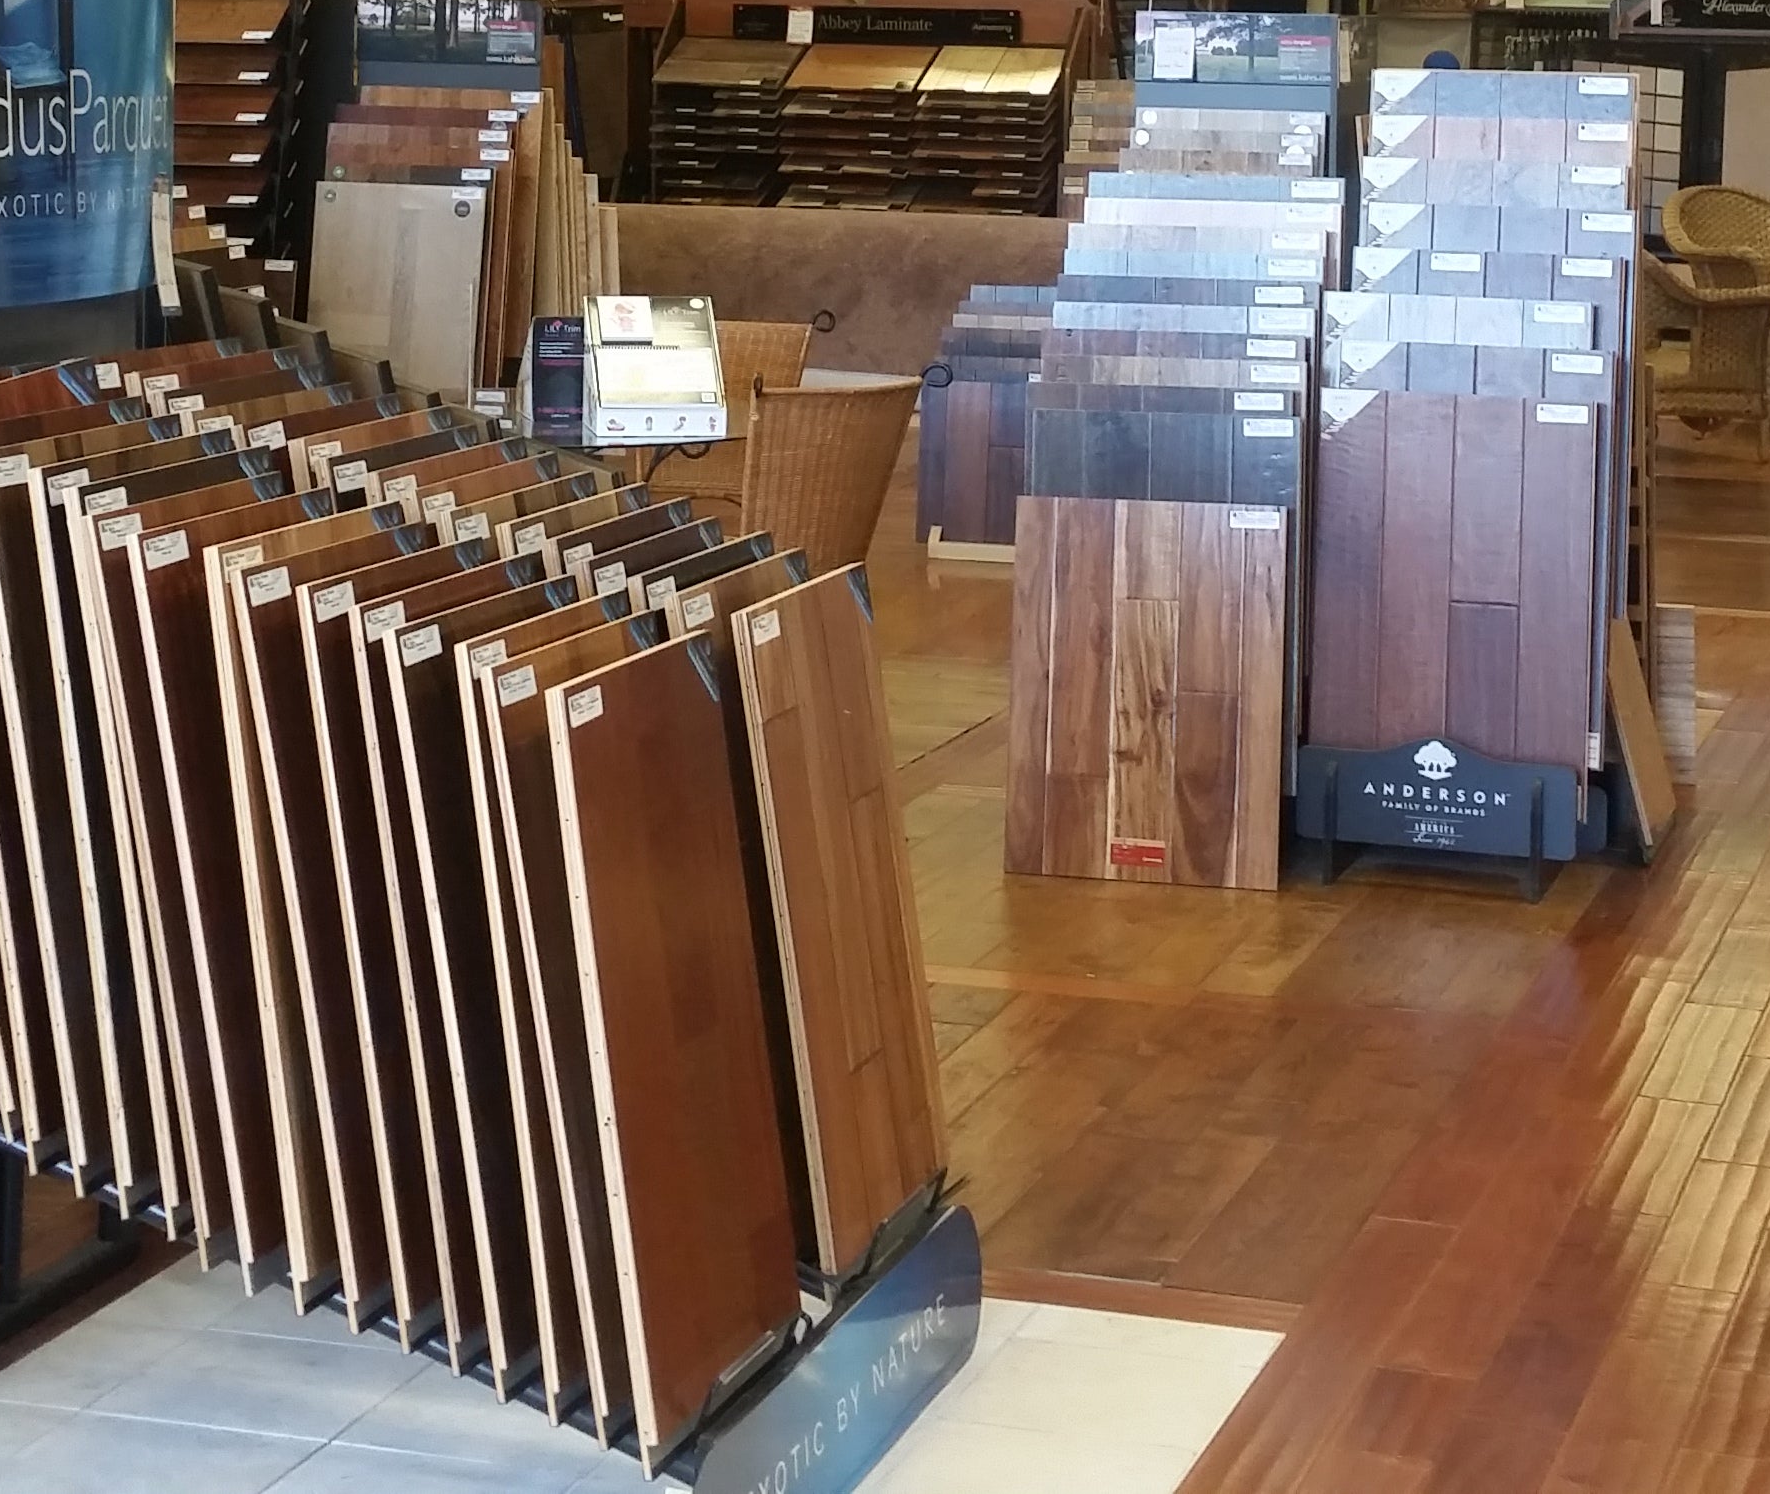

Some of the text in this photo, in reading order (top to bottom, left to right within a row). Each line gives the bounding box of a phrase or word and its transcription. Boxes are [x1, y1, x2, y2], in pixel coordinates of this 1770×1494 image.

[818, 15, 933, 33] Abbey Laminate
[77, 191, 98, 214] BY
[1382, 800, 1486, 817] FAMILY OF BRANDS
[747, 1292, 947, 1494] XOTIC BY NATURE
